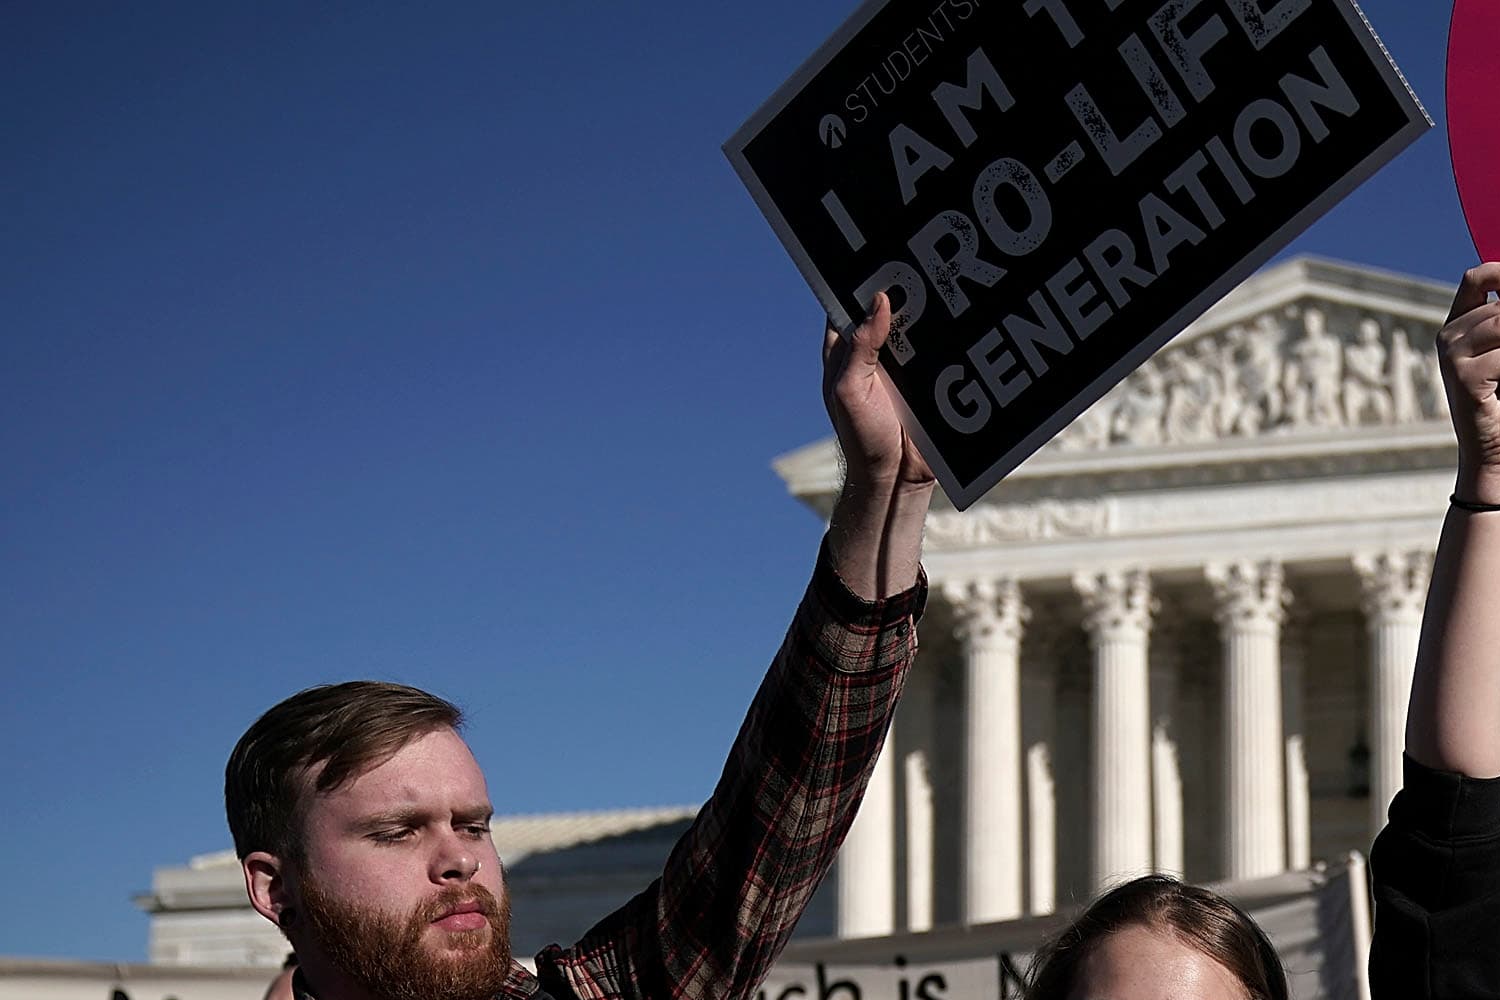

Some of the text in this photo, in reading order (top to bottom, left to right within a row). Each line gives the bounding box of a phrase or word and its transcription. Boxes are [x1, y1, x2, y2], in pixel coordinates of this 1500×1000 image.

[821, 190, 867, 252] I
[889, 46, 1016, 206] AM
[934, 45, 1360, 434] GENERATION
